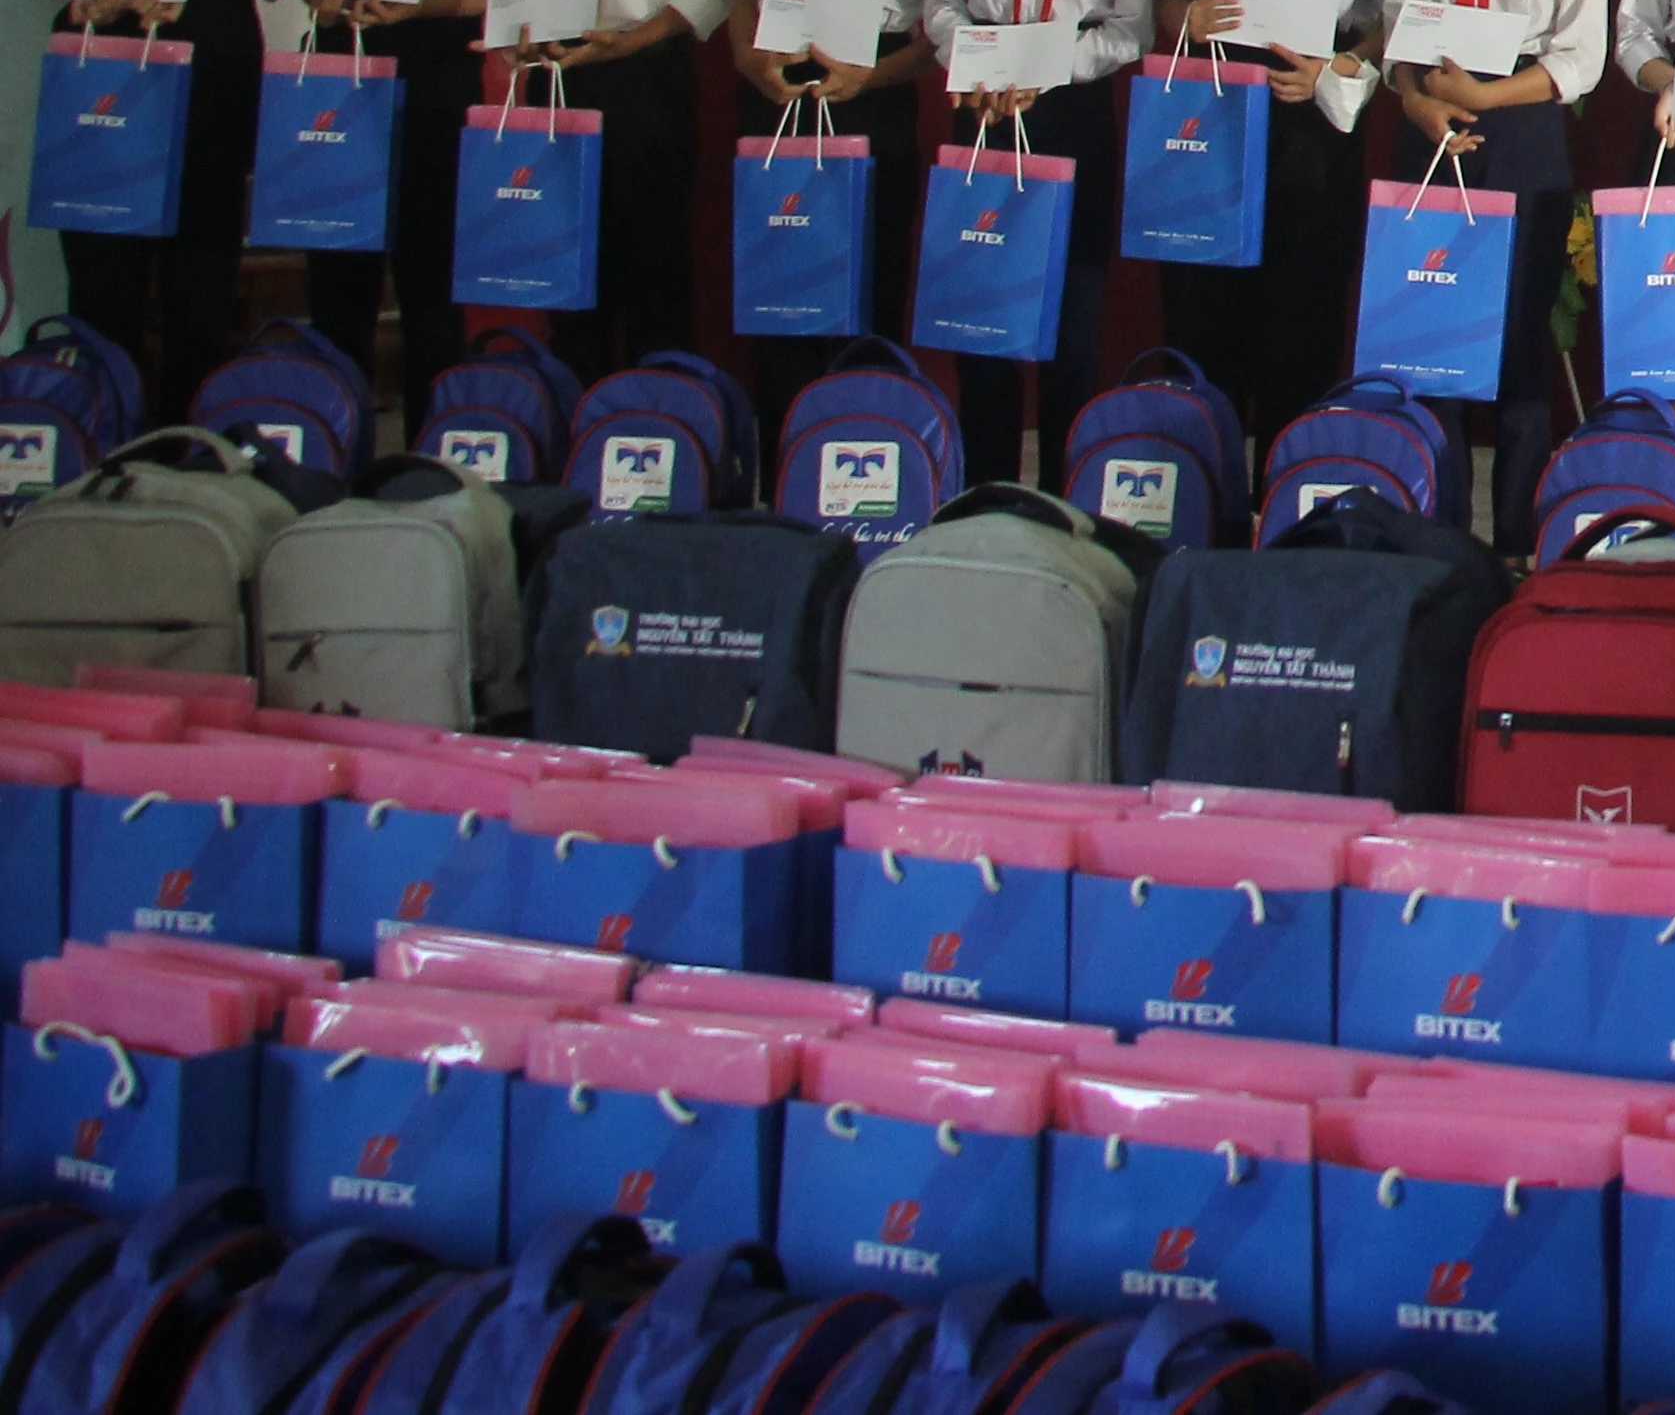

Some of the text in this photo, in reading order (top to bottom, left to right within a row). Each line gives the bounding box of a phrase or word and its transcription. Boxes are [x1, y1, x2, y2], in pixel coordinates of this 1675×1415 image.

[77, 114, 126, 127] BITEX
[298, 131, 346, 142] BITEX
[1166, 139, 1207, 152] BITEX
[496, 188, 541, 199] BITEX
[769, 215, 809, 226] BITEX
[961, 230, 1004, 244] BITEX
[1407, 270, 1456, 284] BITEX
[134, 908, 214, 935] BITEX
[903, 971, 980, 1000] BITEX
[1144, 1000, 1233, 1027] BITEX
[1415, 1014, 1500, 1043] BITEX
[330, 1175, 415, 1206] BITEX
[854, 1241, 940, 1276] BITEX
[1121, 1270, 1218, 1303] BITEX
[1397, 1305, 1496, 1333] BITEX
